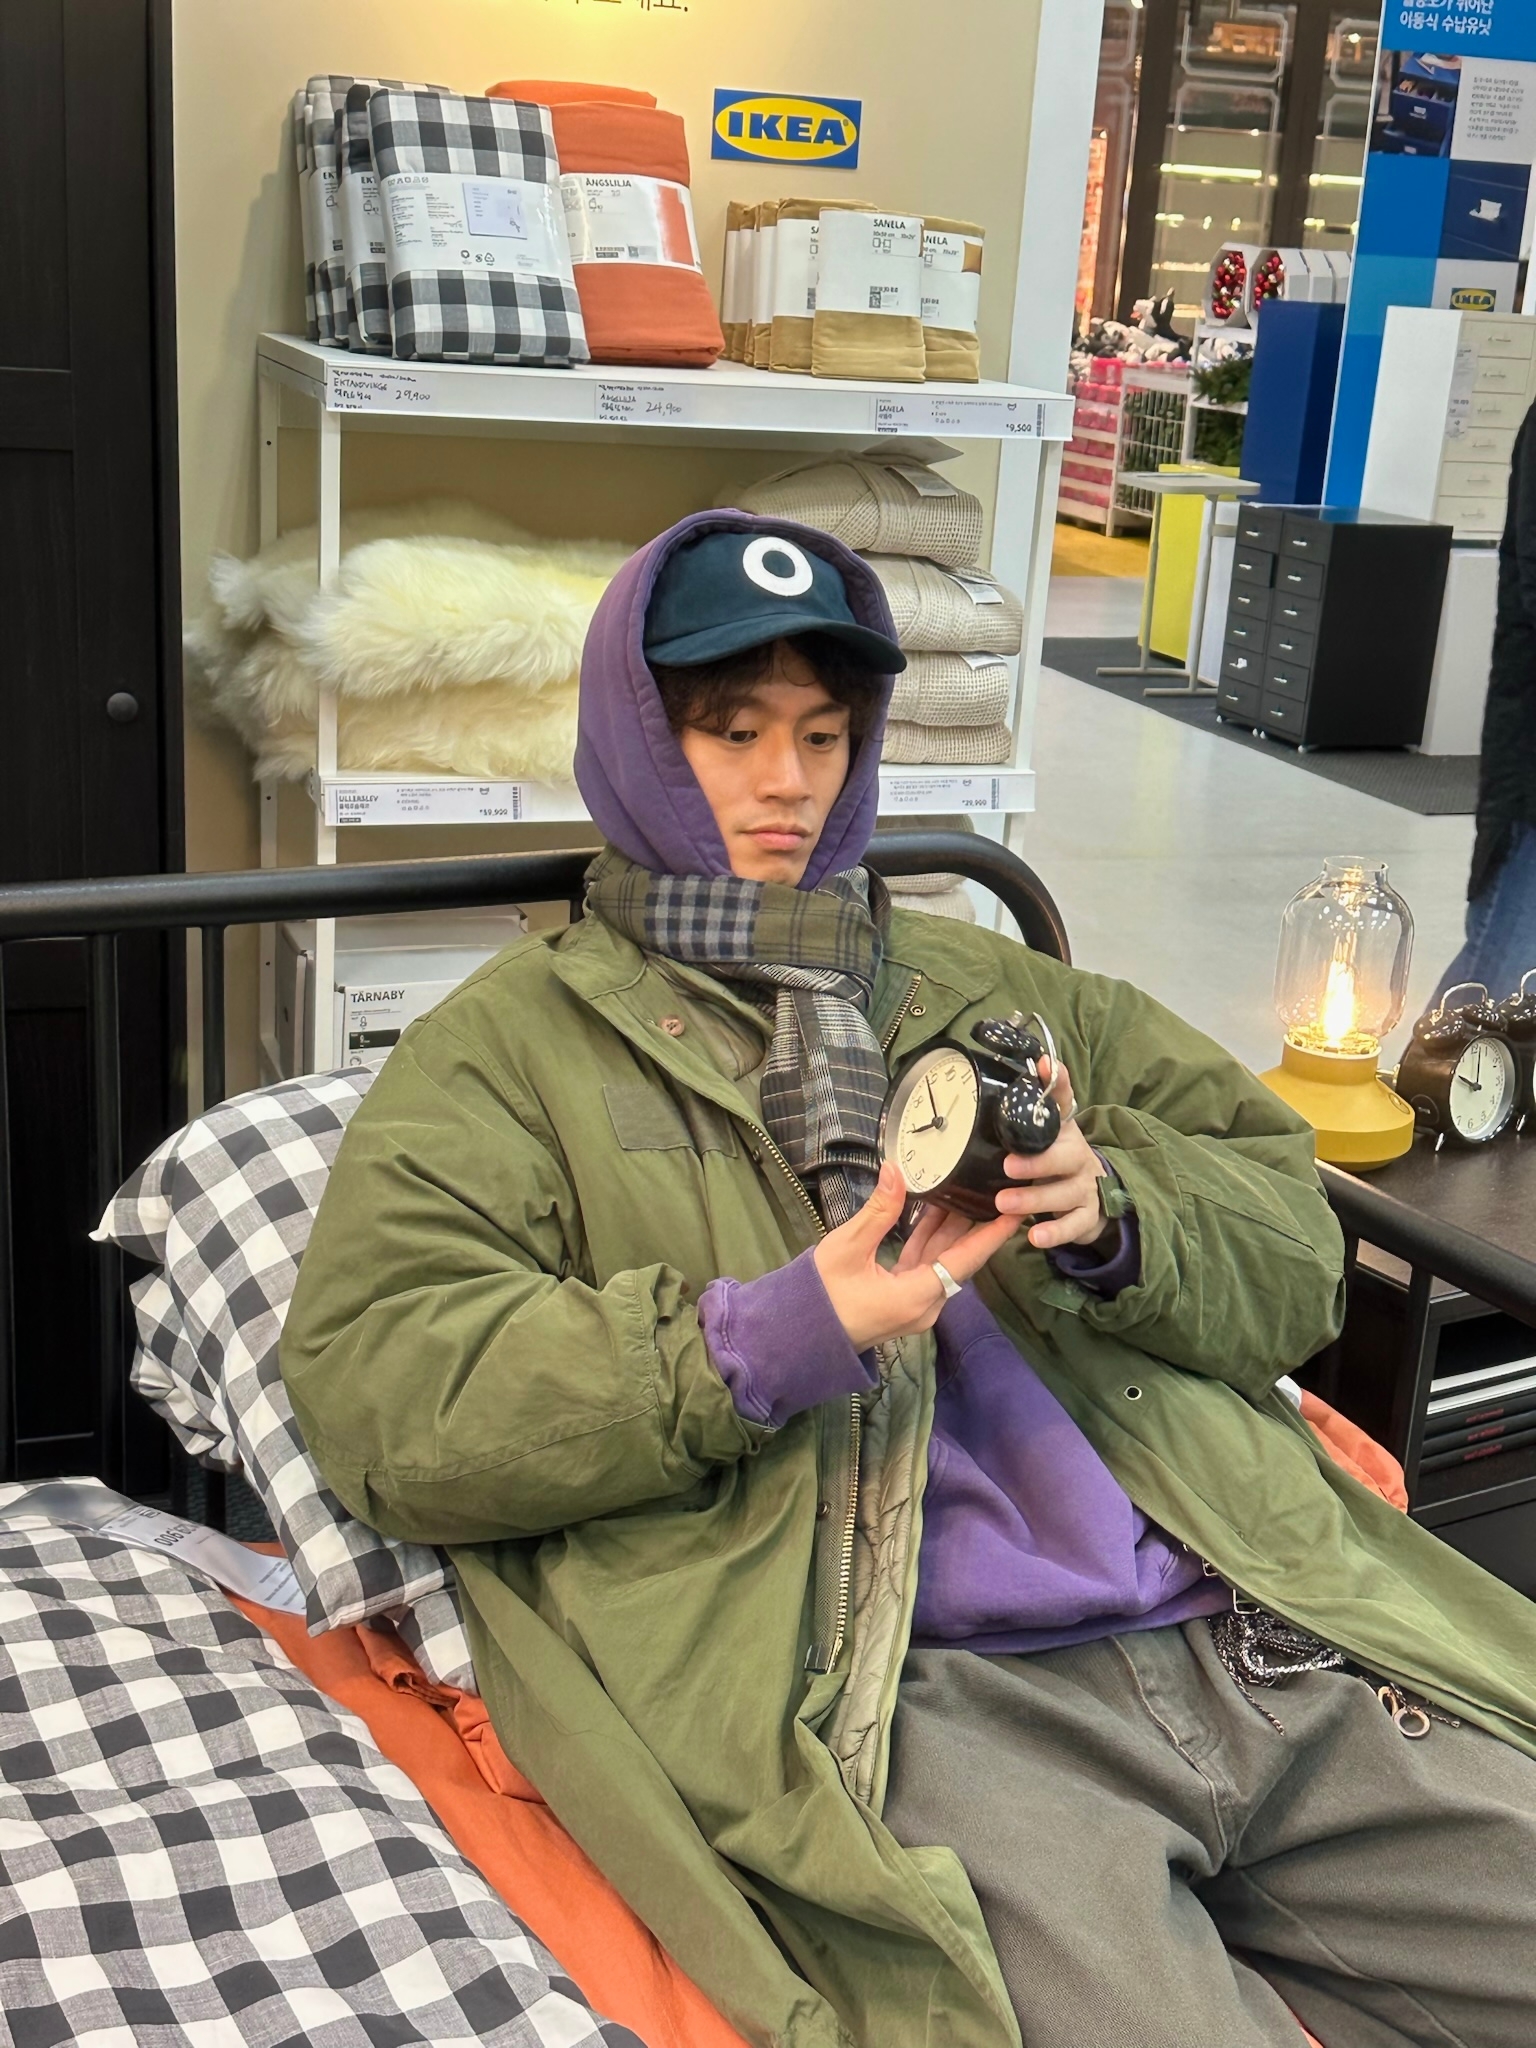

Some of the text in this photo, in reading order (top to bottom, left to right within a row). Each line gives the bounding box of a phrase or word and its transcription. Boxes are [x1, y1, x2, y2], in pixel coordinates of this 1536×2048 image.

[1399, 10, 1492, 36] 이동식 수납유닛
[728, 110, 848, 146] IKEA
[873, 218, 906, 230] SANELA
[1454, 295, 1491, 306] IKEA
[395, 389, 431, 401] 29,900
[645, 401, 682, 417] 24,900
[350, 990, 405, 1003] TÄRNABY
[912, 1095, 924, 1109] 8
